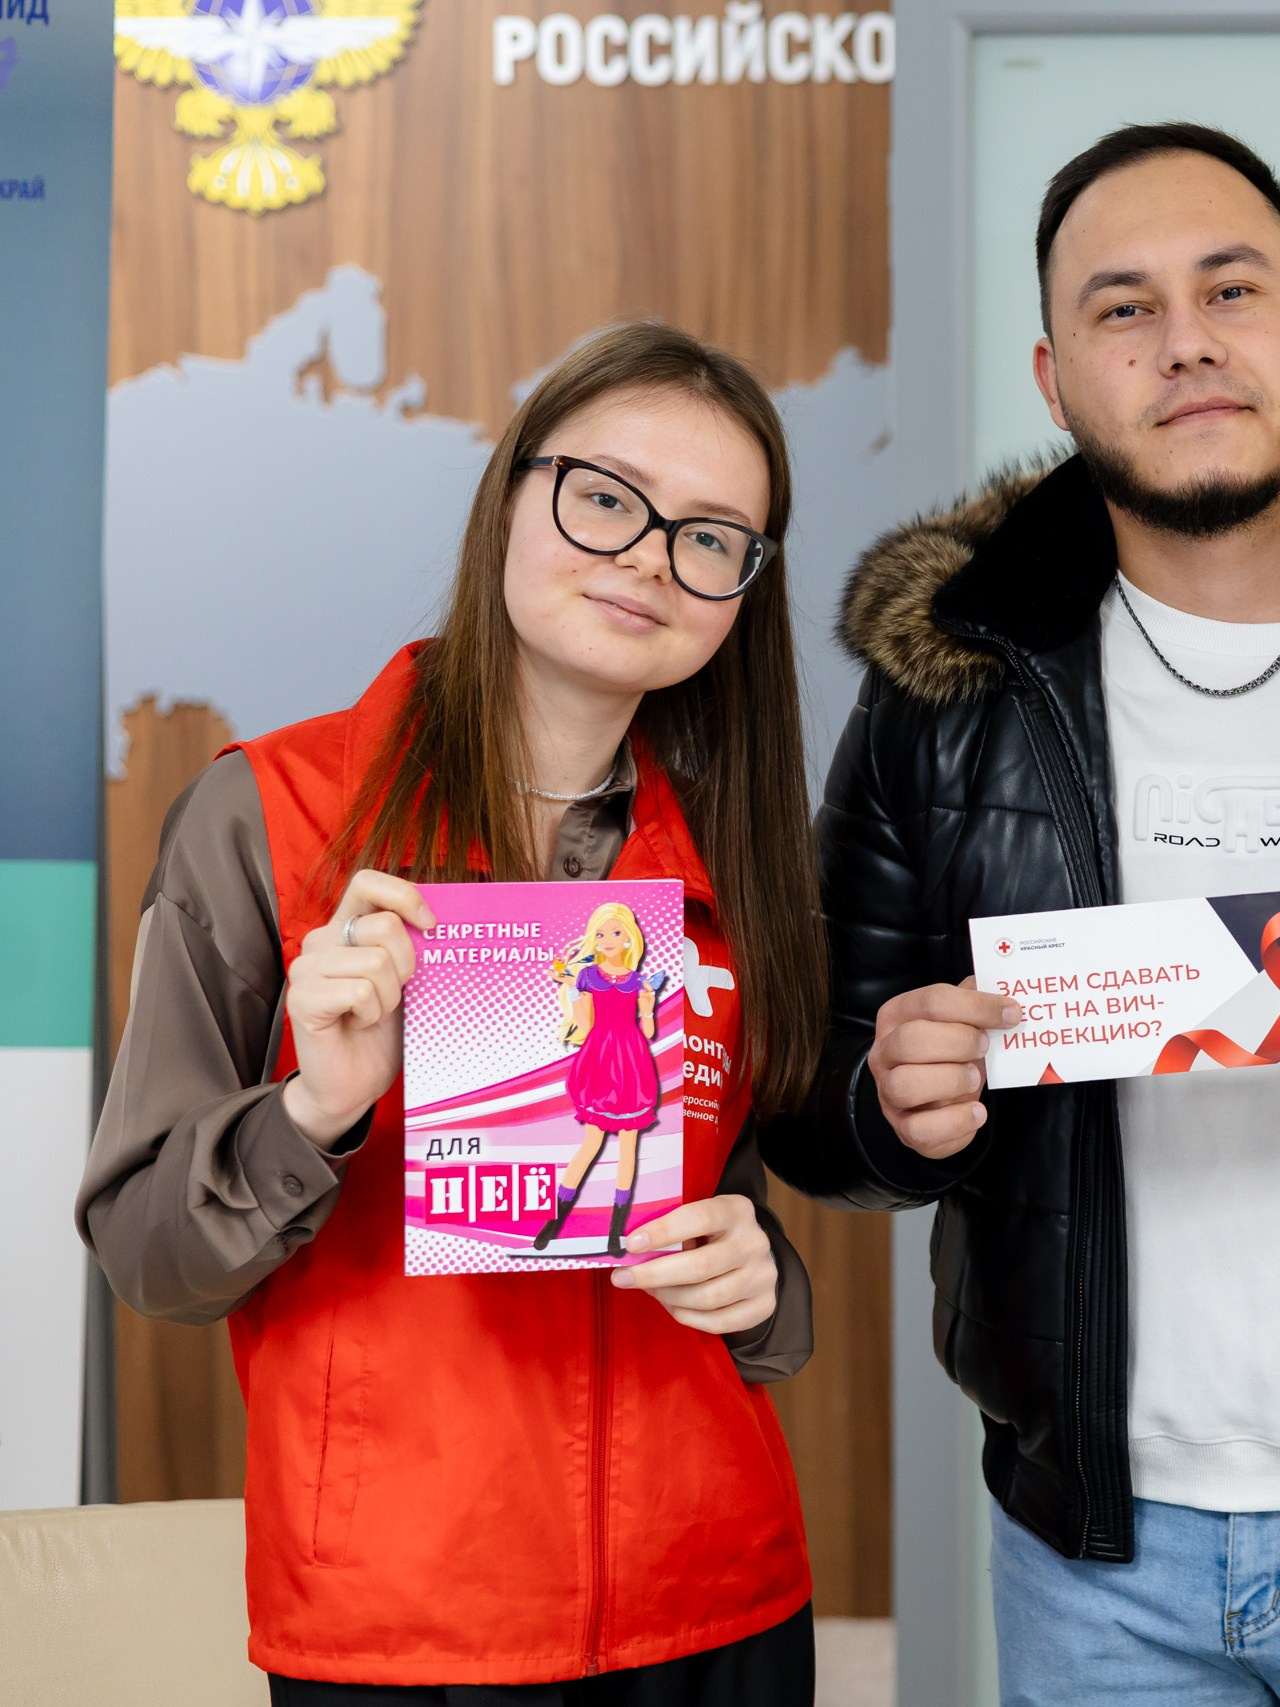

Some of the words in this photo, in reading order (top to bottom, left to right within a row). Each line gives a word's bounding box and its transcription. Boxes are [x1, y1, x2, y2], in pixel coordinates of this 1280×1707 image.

[0, 0, 49, 26] ИД
[492, 0, 896, 86] РОССИЙСКО
[1154, 832, 1221, 848] ROAD
[423, 922, 542, 940] СЕКРЕТНЫЕ
[423, 946, 555, 965] МАТЕРИАЛЫ
[996, 974, 1079, 997] ЗАЧЕМ
[1086, 963, 1201, 991] СДАВАТЬ
[1020, 1003, 1057, 1023] ЕСТ
[1064, 999, 1100, 1018] НА
[1106, 994, 1165, 1015] ВИЧ-
[1003, 1020, 1163, 1050] ИНФЕКЦИЮ?
[426, 1136, 481, 1161] ДЛЯ
[430, 1166, 552, 1214] НЕЁ
